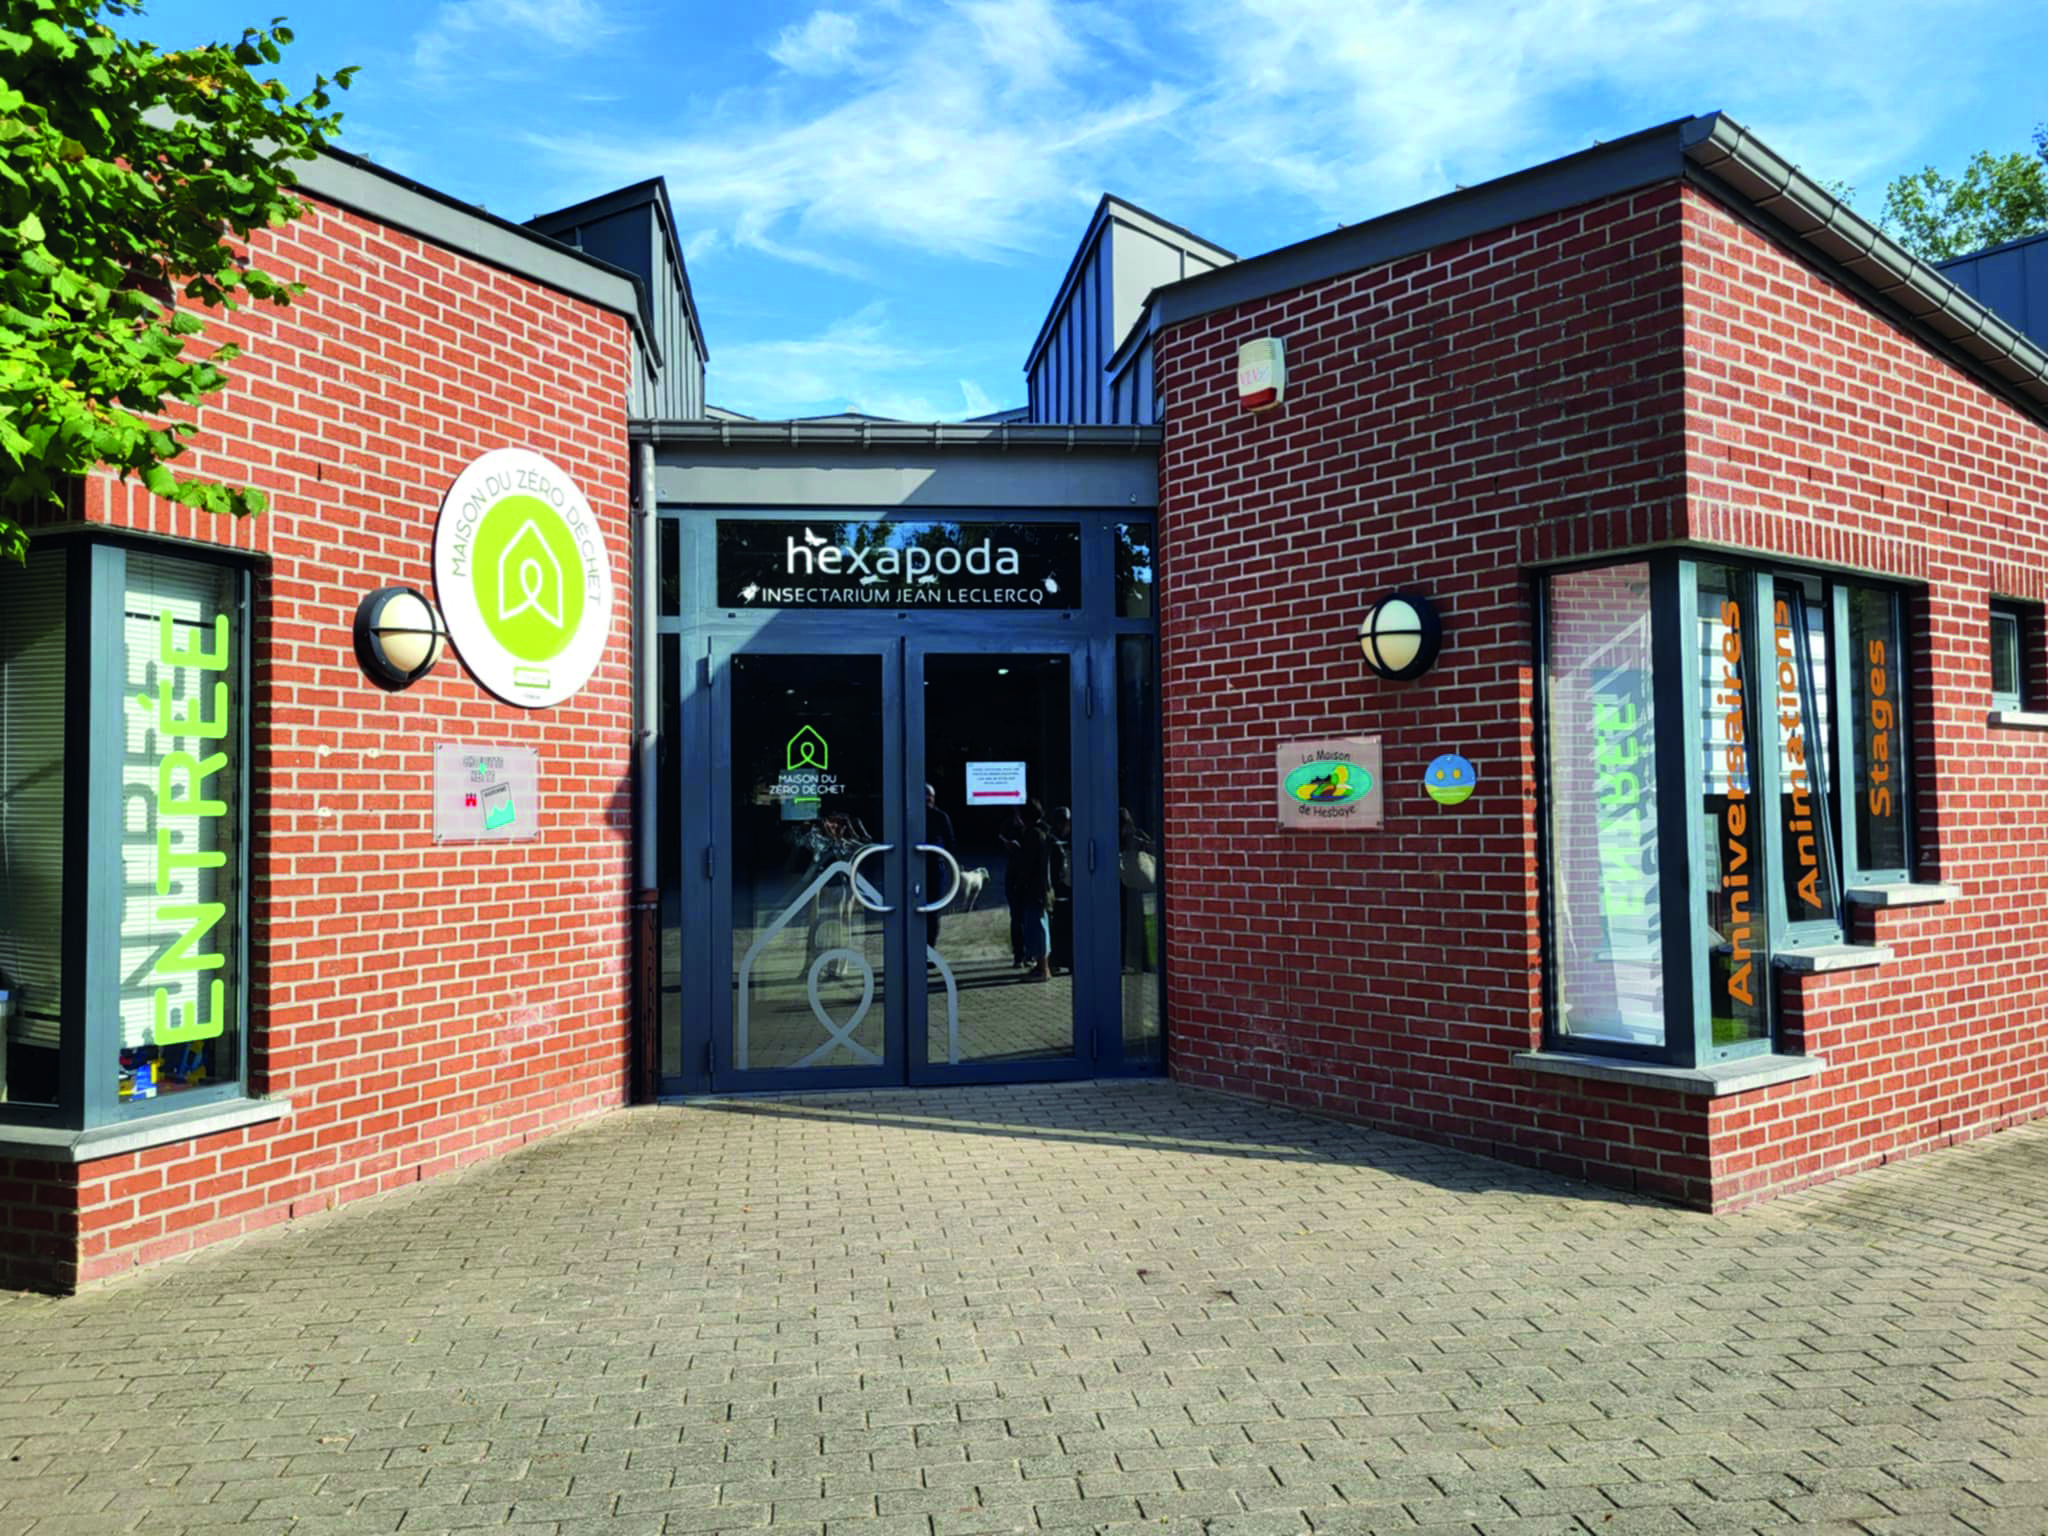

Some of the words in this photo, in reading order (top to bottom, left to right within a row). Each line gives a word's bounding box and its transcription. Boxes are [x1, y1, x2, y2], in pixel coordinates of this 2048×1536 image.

[451, 487, 488, 578] MAISON
[485, 470, 512, 498] DU
[515, 468, 566, 508] ZÉRO
[786, 535, 1020, 584] hexapoda
[761, 587, 891, 604] INSECTARIUM
[895, 587, 943, 604] JEAN
[947, 588, 1044, 606] LECLERCQ
[1301, 753, 1314, 764] La
[1316, 749, 1351, 762] Maison
[1773, 599, 1823, 910] Animations
[1868, 638, 1894, 818] Stages
[778, 774, 819, 784] MAISON
[821, 774, 837, 784] DU
[1298, 804, 1311, 816] de
[1313, 805, 1357, 819] Hesbaye
[1716, 599, 1754, 1007] Anniversaires
[137, 608, 229, 1046] ENTRÉE
